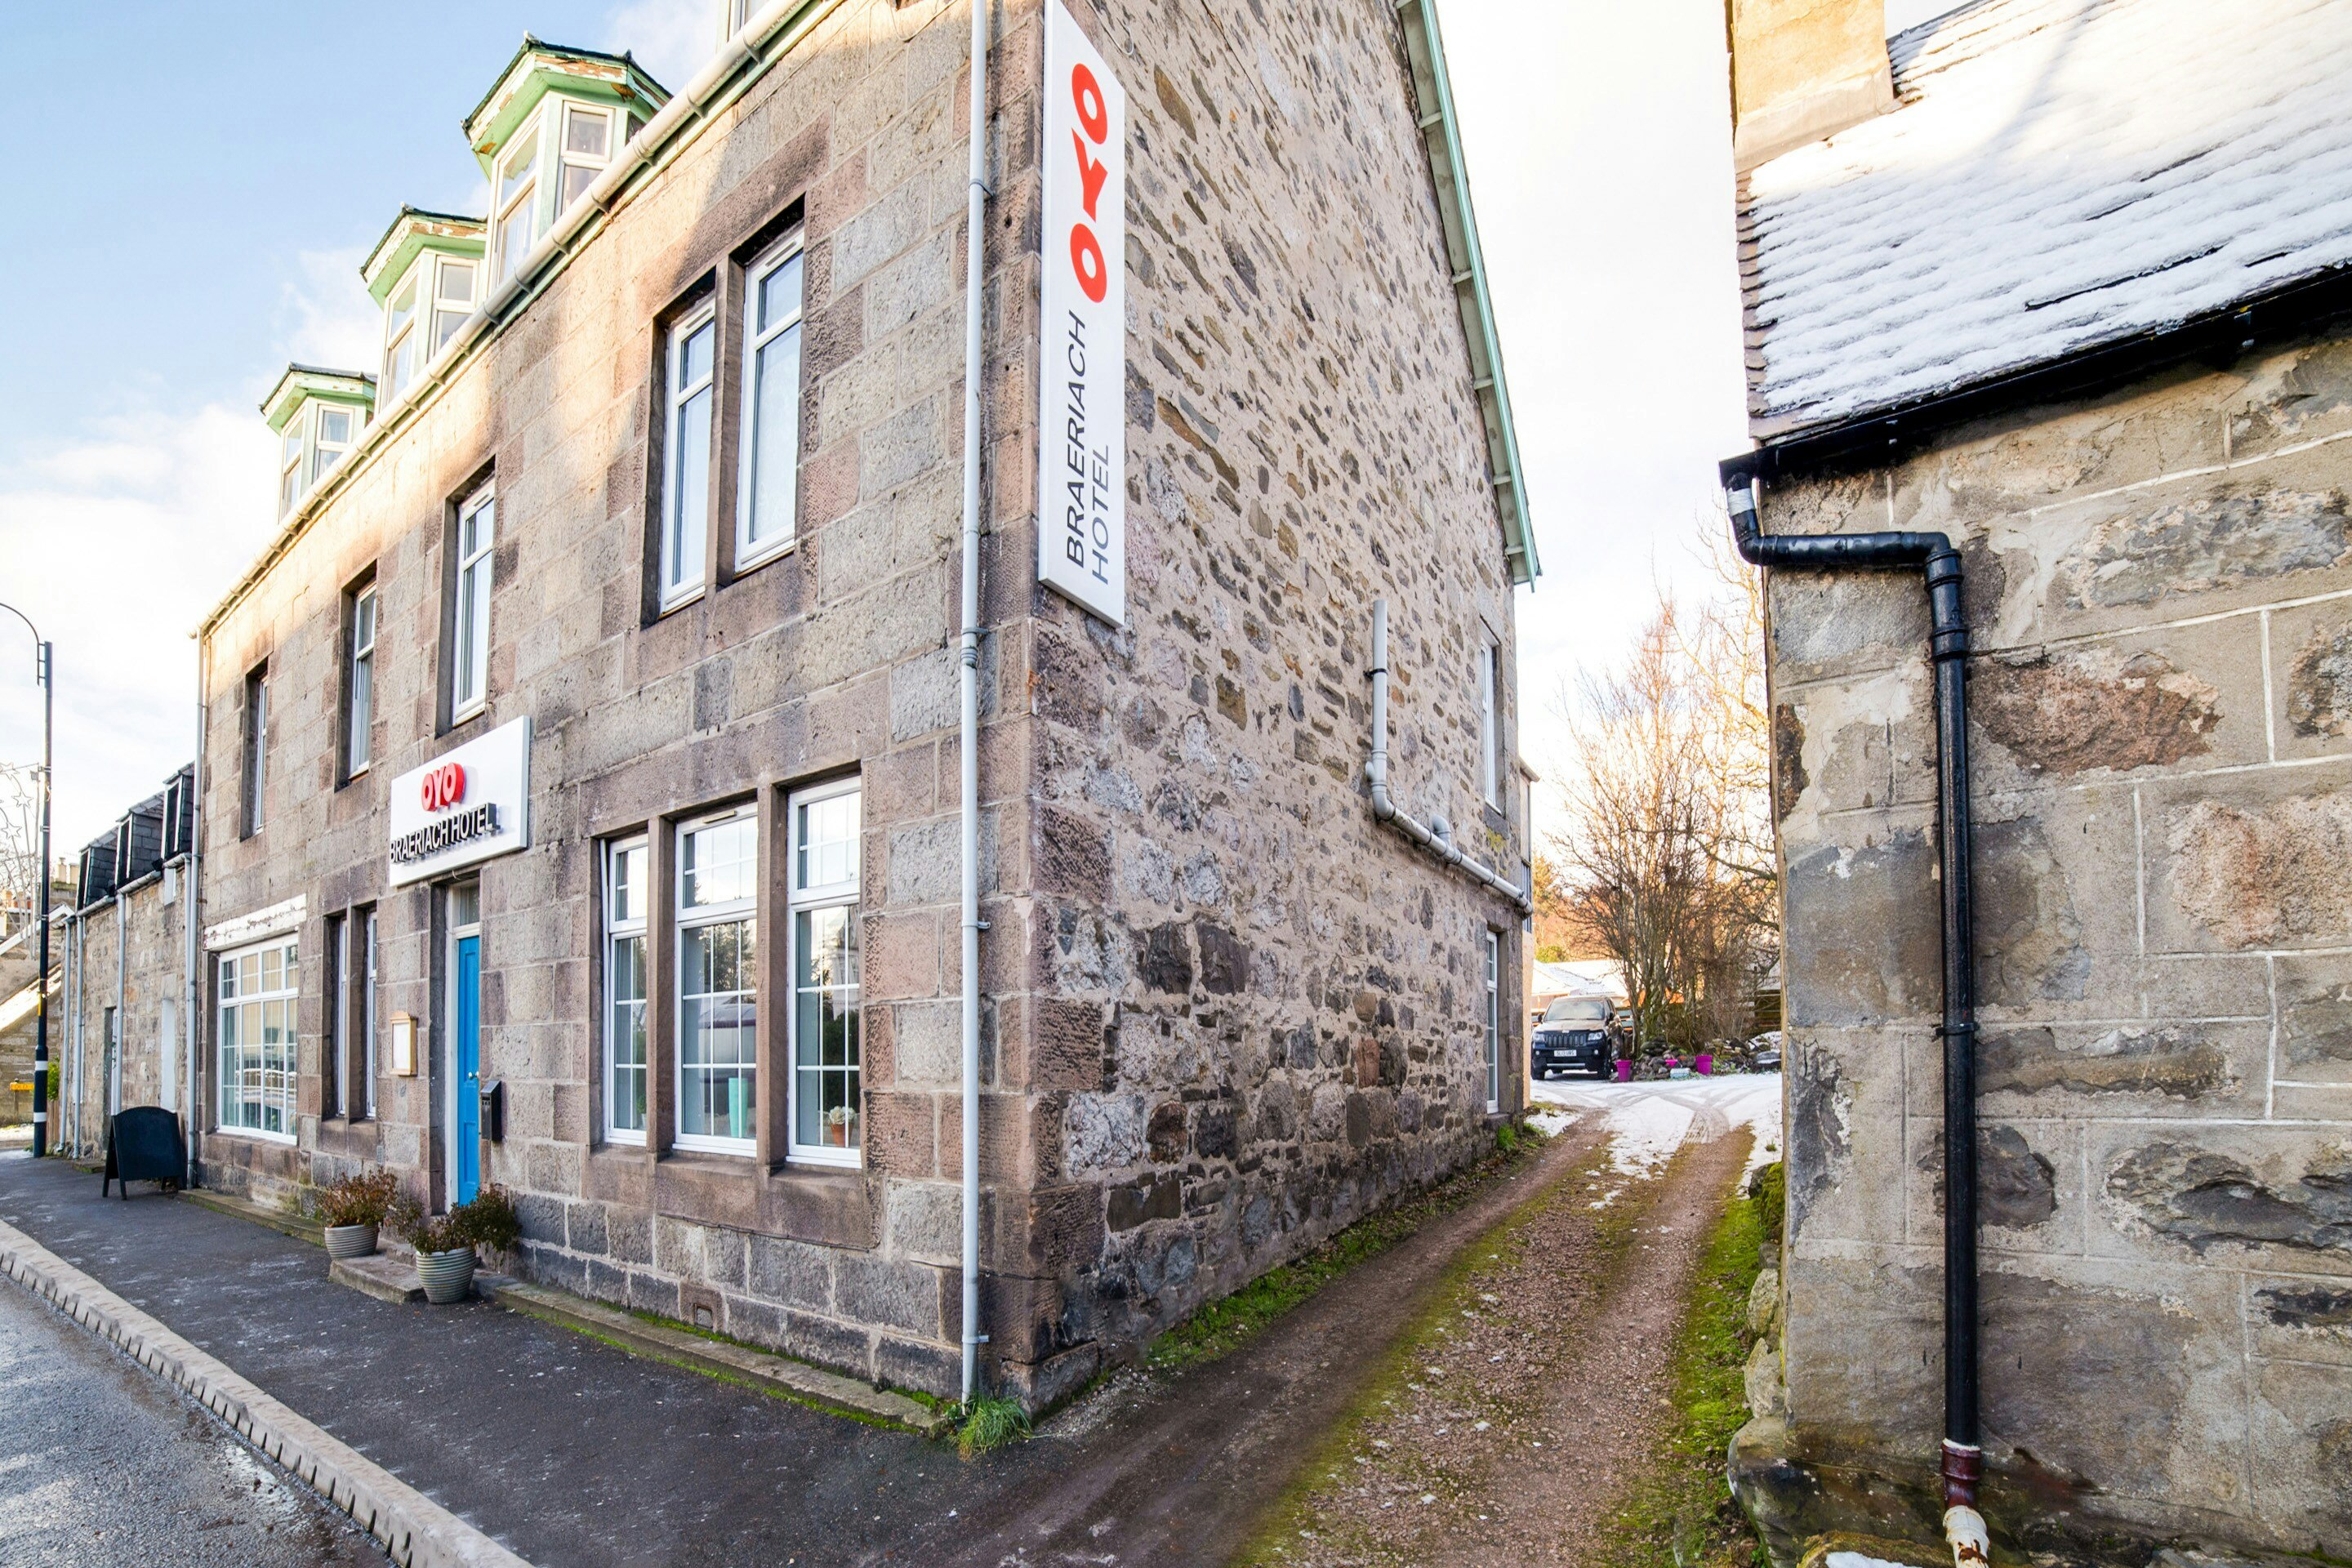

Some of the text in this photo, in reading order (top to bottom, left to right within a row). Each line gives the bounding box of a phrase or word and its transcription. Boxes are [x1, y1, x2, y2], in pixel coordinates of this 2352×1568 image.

[1071, 63, 1108, 303] OYO
[1067, 310, 1085, 568] BRAERIACH
[1092, 444, 1109, 585] HOTEL
[390, 802, 497, 862] BRAERIACH HOTEL
[421, 762, 466, 813] OYO
